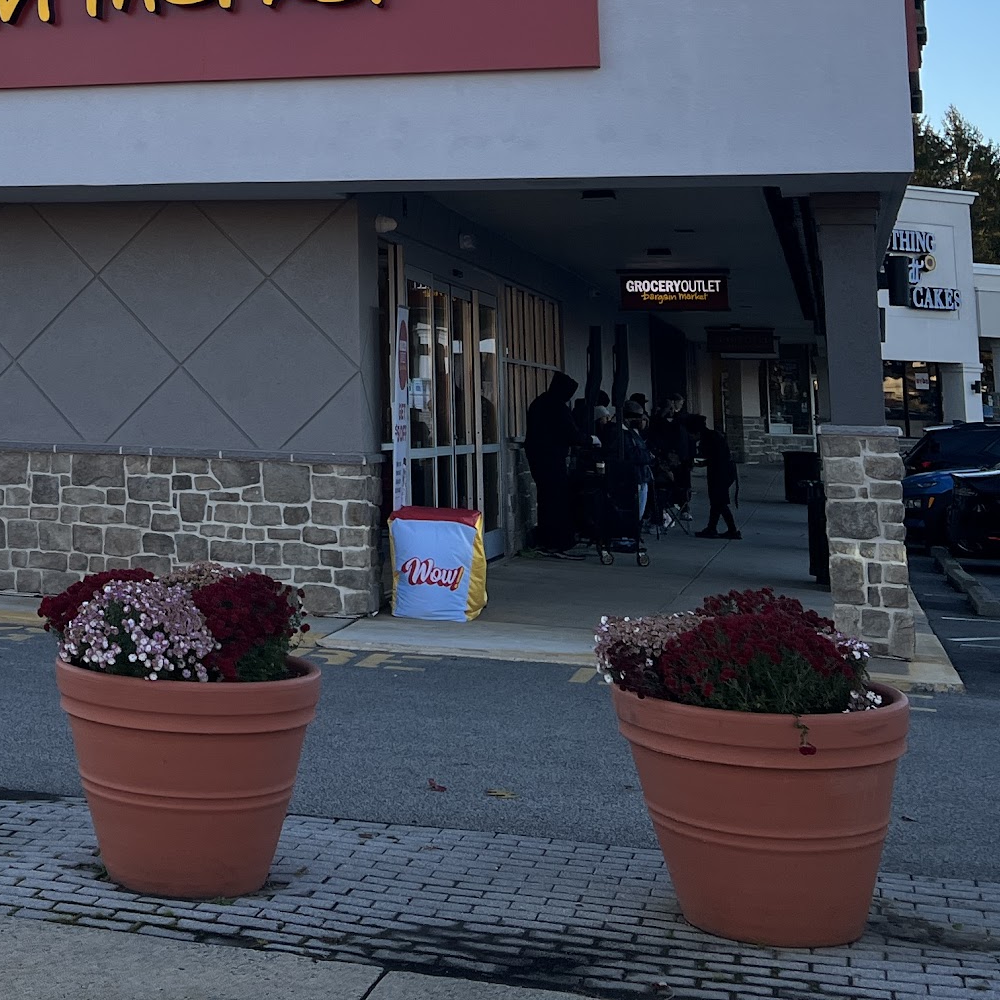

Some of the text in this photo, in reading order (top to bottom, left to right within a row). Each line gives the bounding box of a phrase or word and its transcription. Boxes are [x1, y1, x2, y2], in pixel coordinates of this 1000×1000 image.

[888, 229, 936, 253] THING
[641, 292, 709, 305] bargain market
[912, 286, 962, 310] CAKES
[401, 556, 465, 591] Wow!
